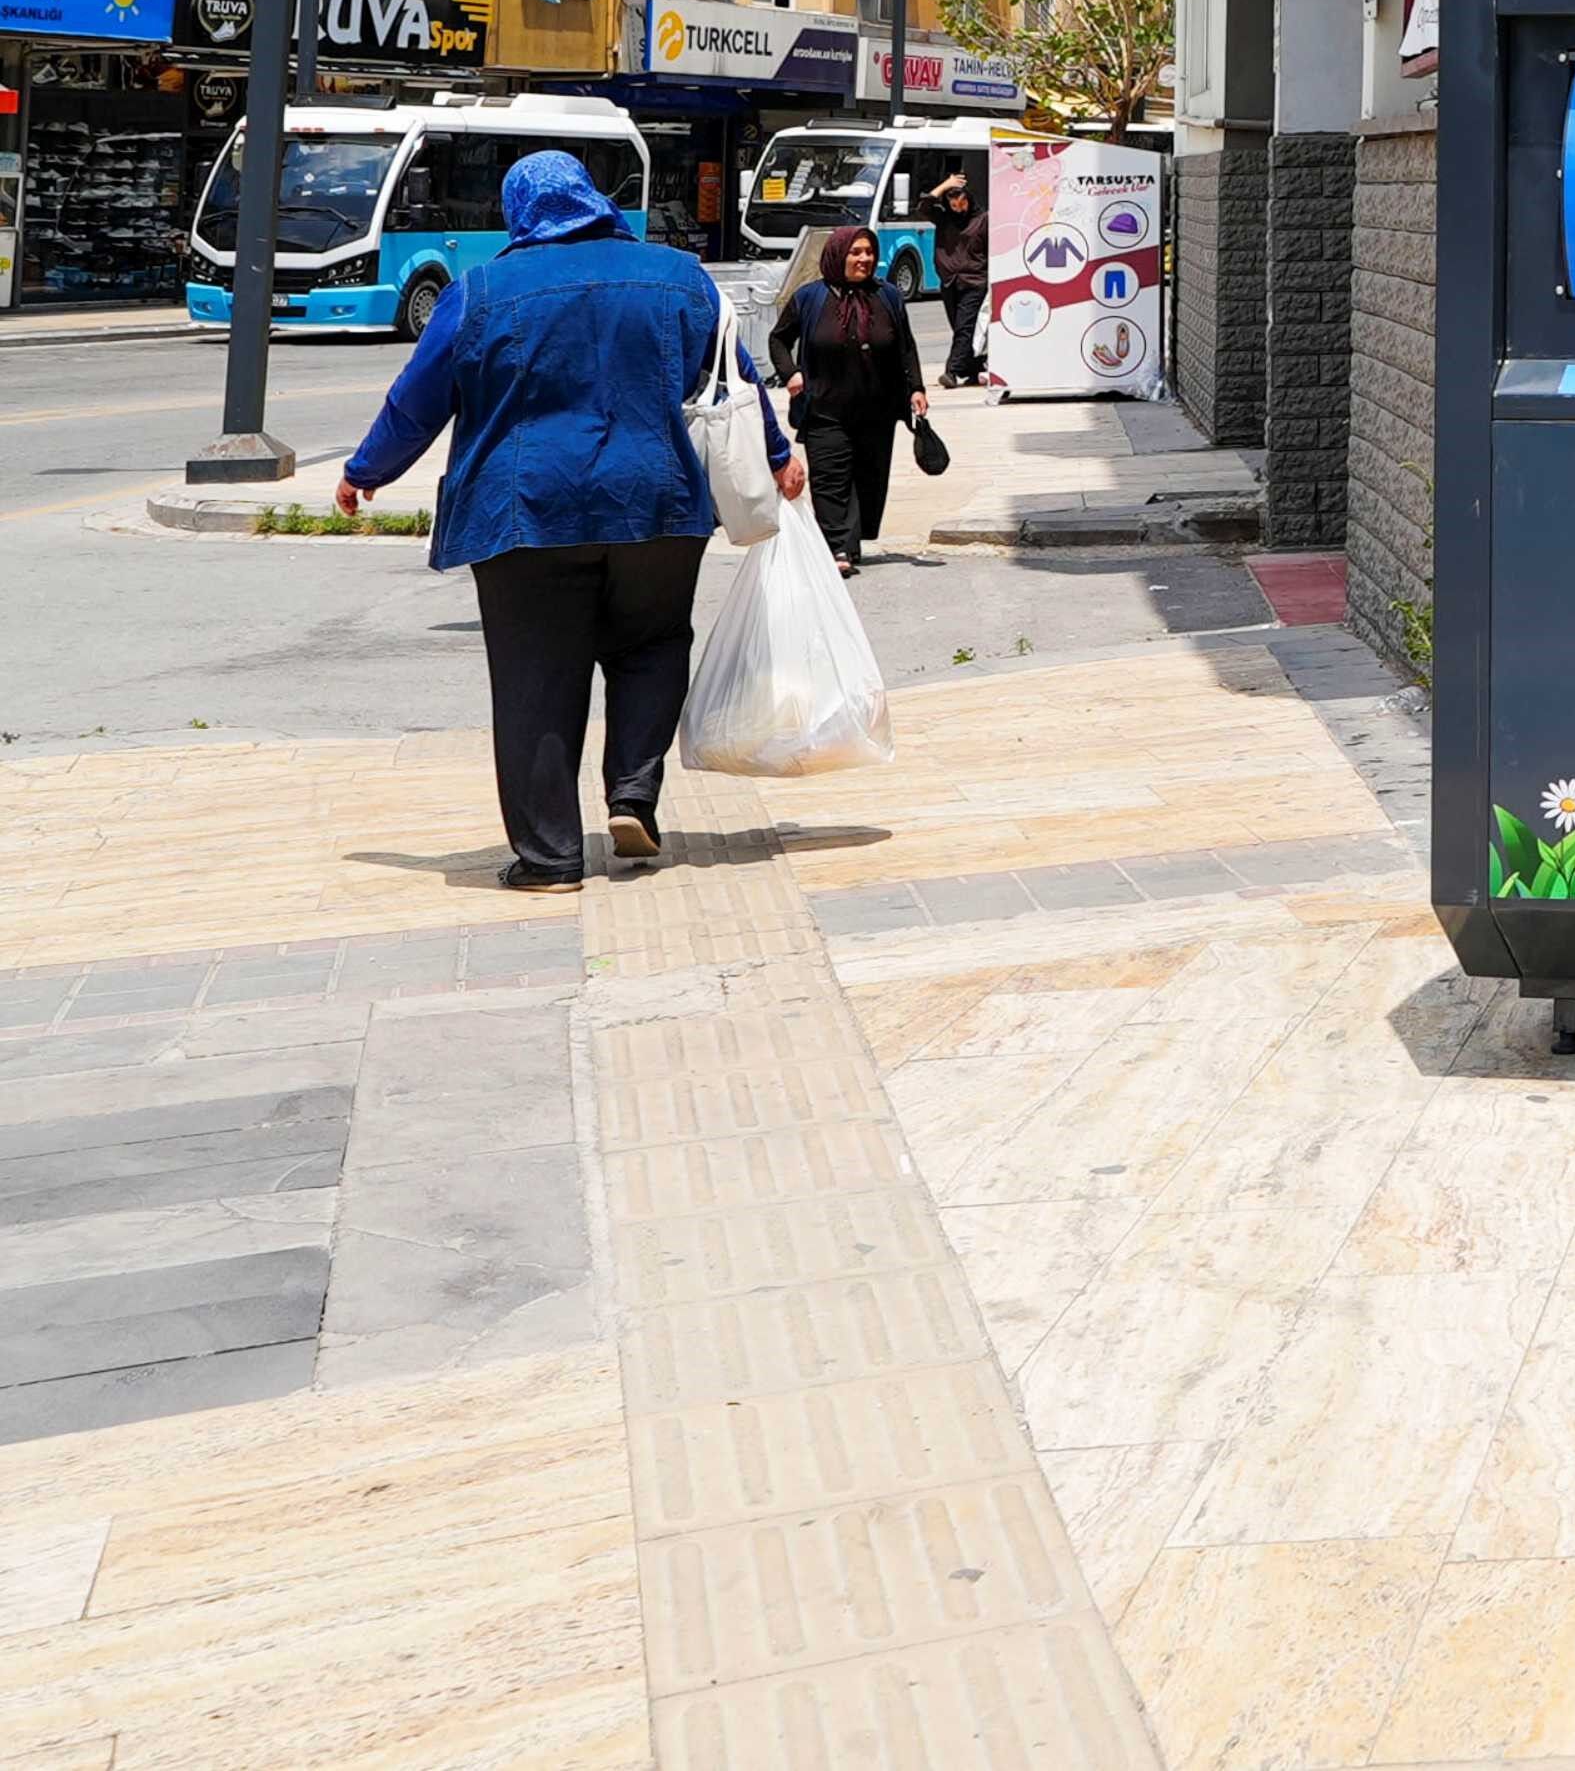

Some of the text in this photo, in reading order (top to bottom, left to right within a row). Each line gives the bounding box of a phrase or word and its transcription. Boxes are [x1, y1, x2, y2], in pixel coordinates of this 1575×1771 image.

[430, 20, 478, 56] Spor
[686, 25, 772, 57] TURKCELL
[1077, 175, 1155, 187] TARSUS'TA
